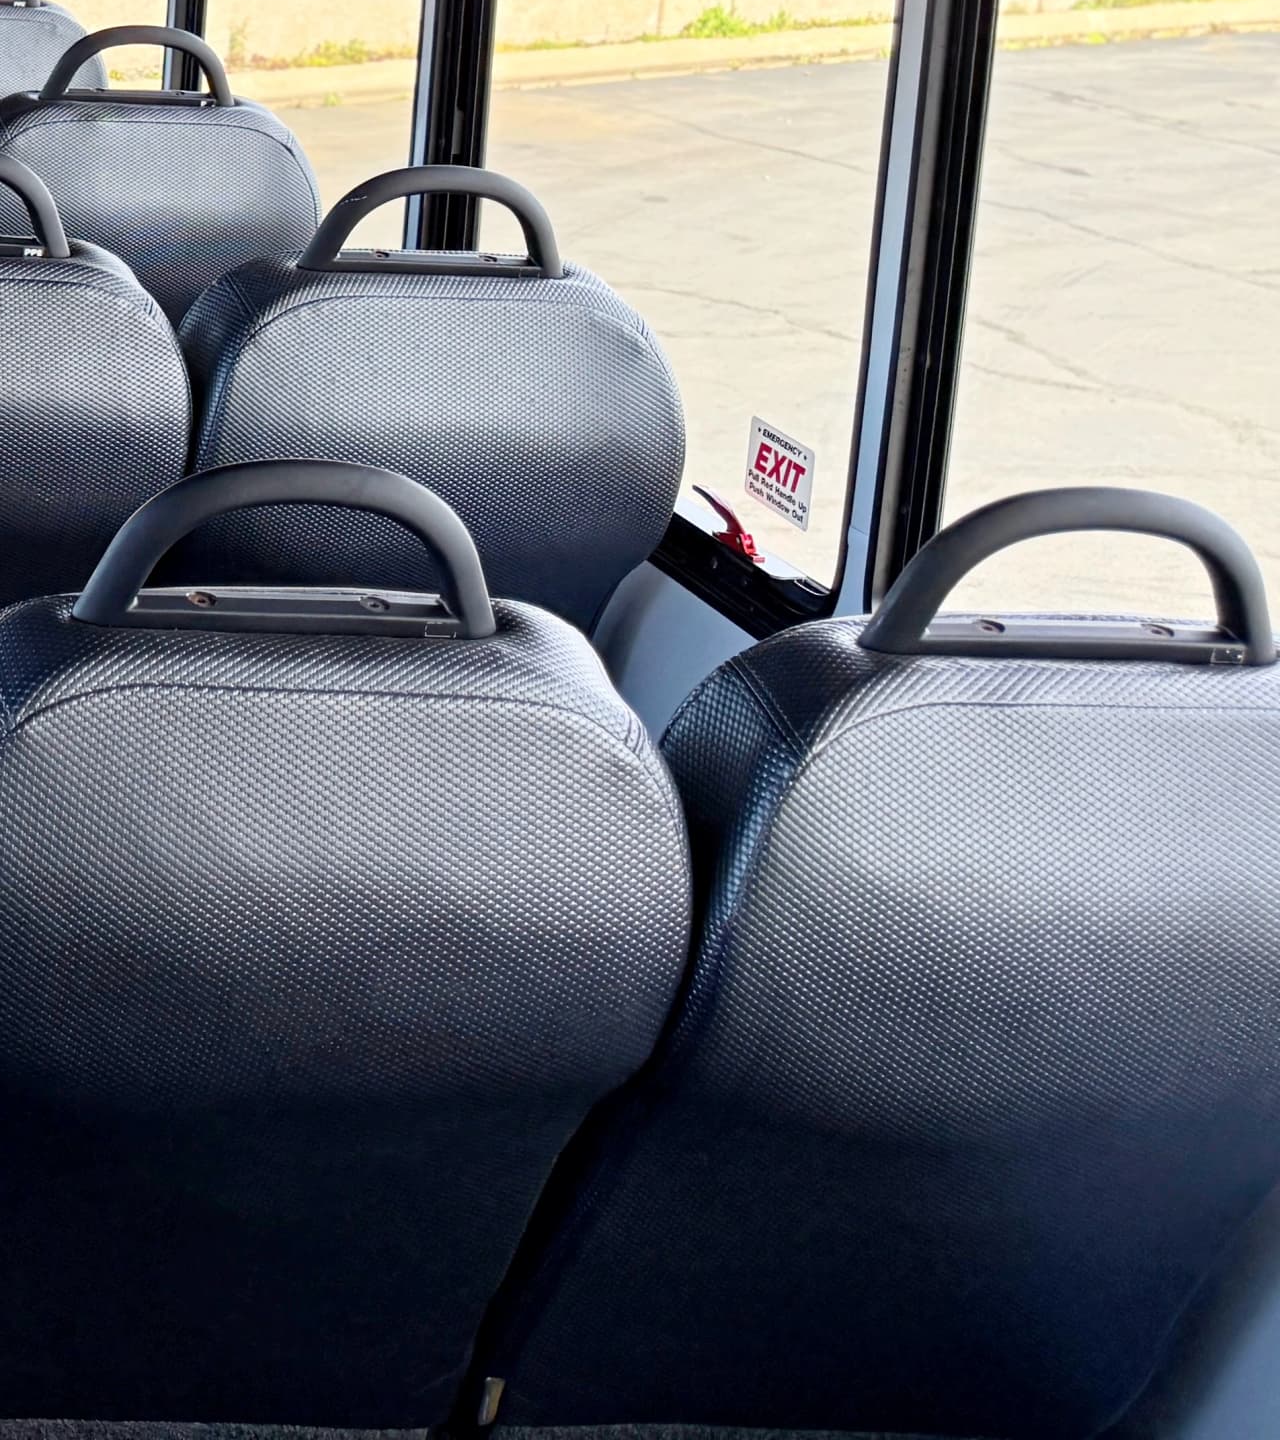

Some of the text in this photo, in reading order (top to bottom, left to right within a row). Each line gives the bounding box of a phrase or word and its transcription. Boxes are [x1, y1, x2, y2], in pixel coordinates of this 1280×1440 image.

[762, 428, 803, 457] EMERGENCY
[754, 441, 807, 494] EXIT
[748, 469, 807, 513] Pull Red Handle Up
[749, 481, 804, 523] Push Window Out
